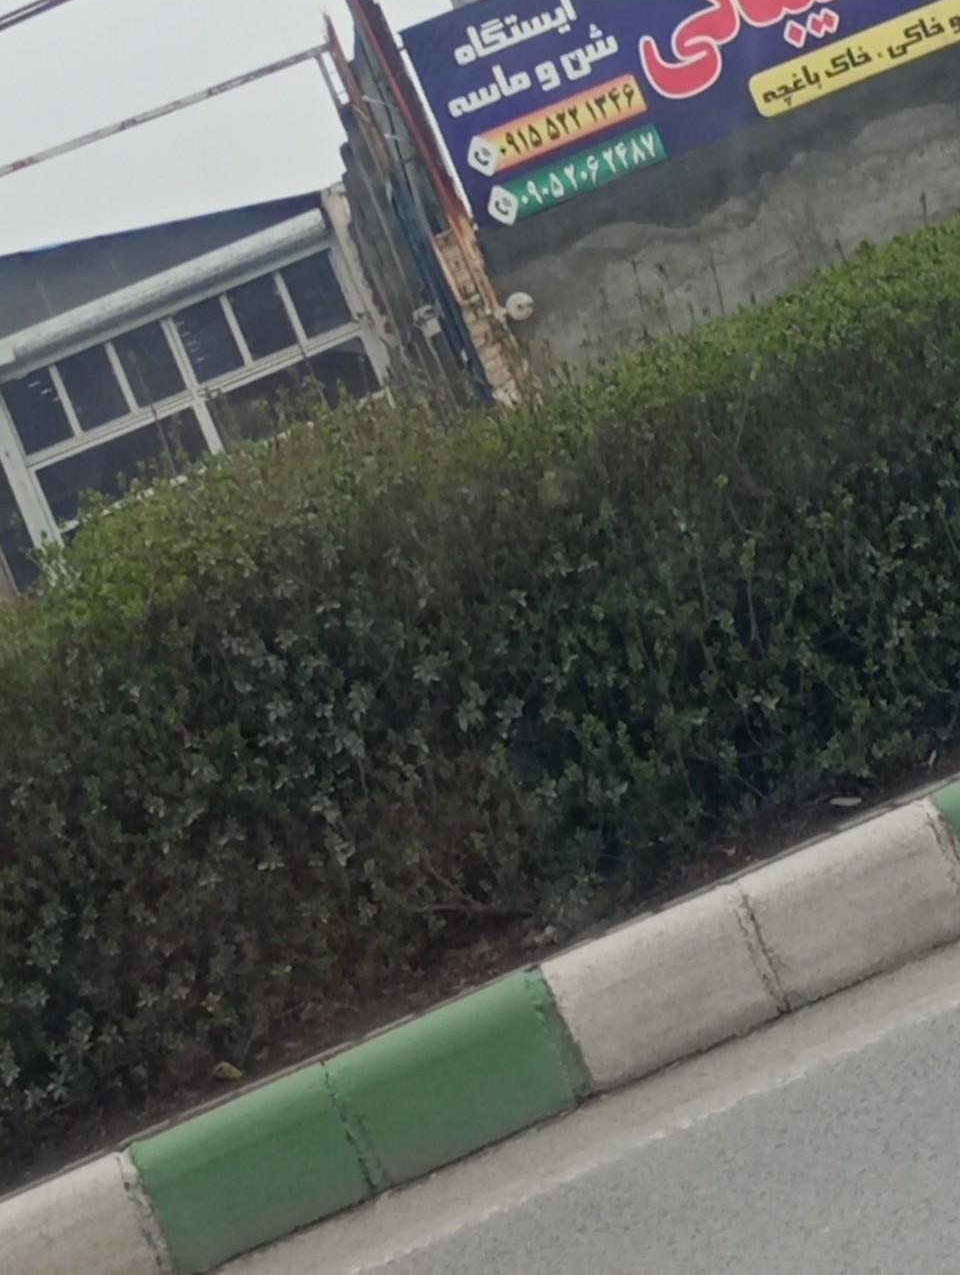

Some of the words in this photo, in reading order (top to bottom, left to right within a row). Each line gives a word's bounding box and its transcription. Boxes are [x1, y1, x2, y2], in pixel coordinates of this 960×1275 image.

[560, 23, 619, 81] شن
[887, 17, 945, 60] خاکی
[534, 60, 561, 92] و
[824, 46, 872, 79] خاک
[448, 64, 532, 118] ماسه
[762, 64, 822, 106] باغچه
